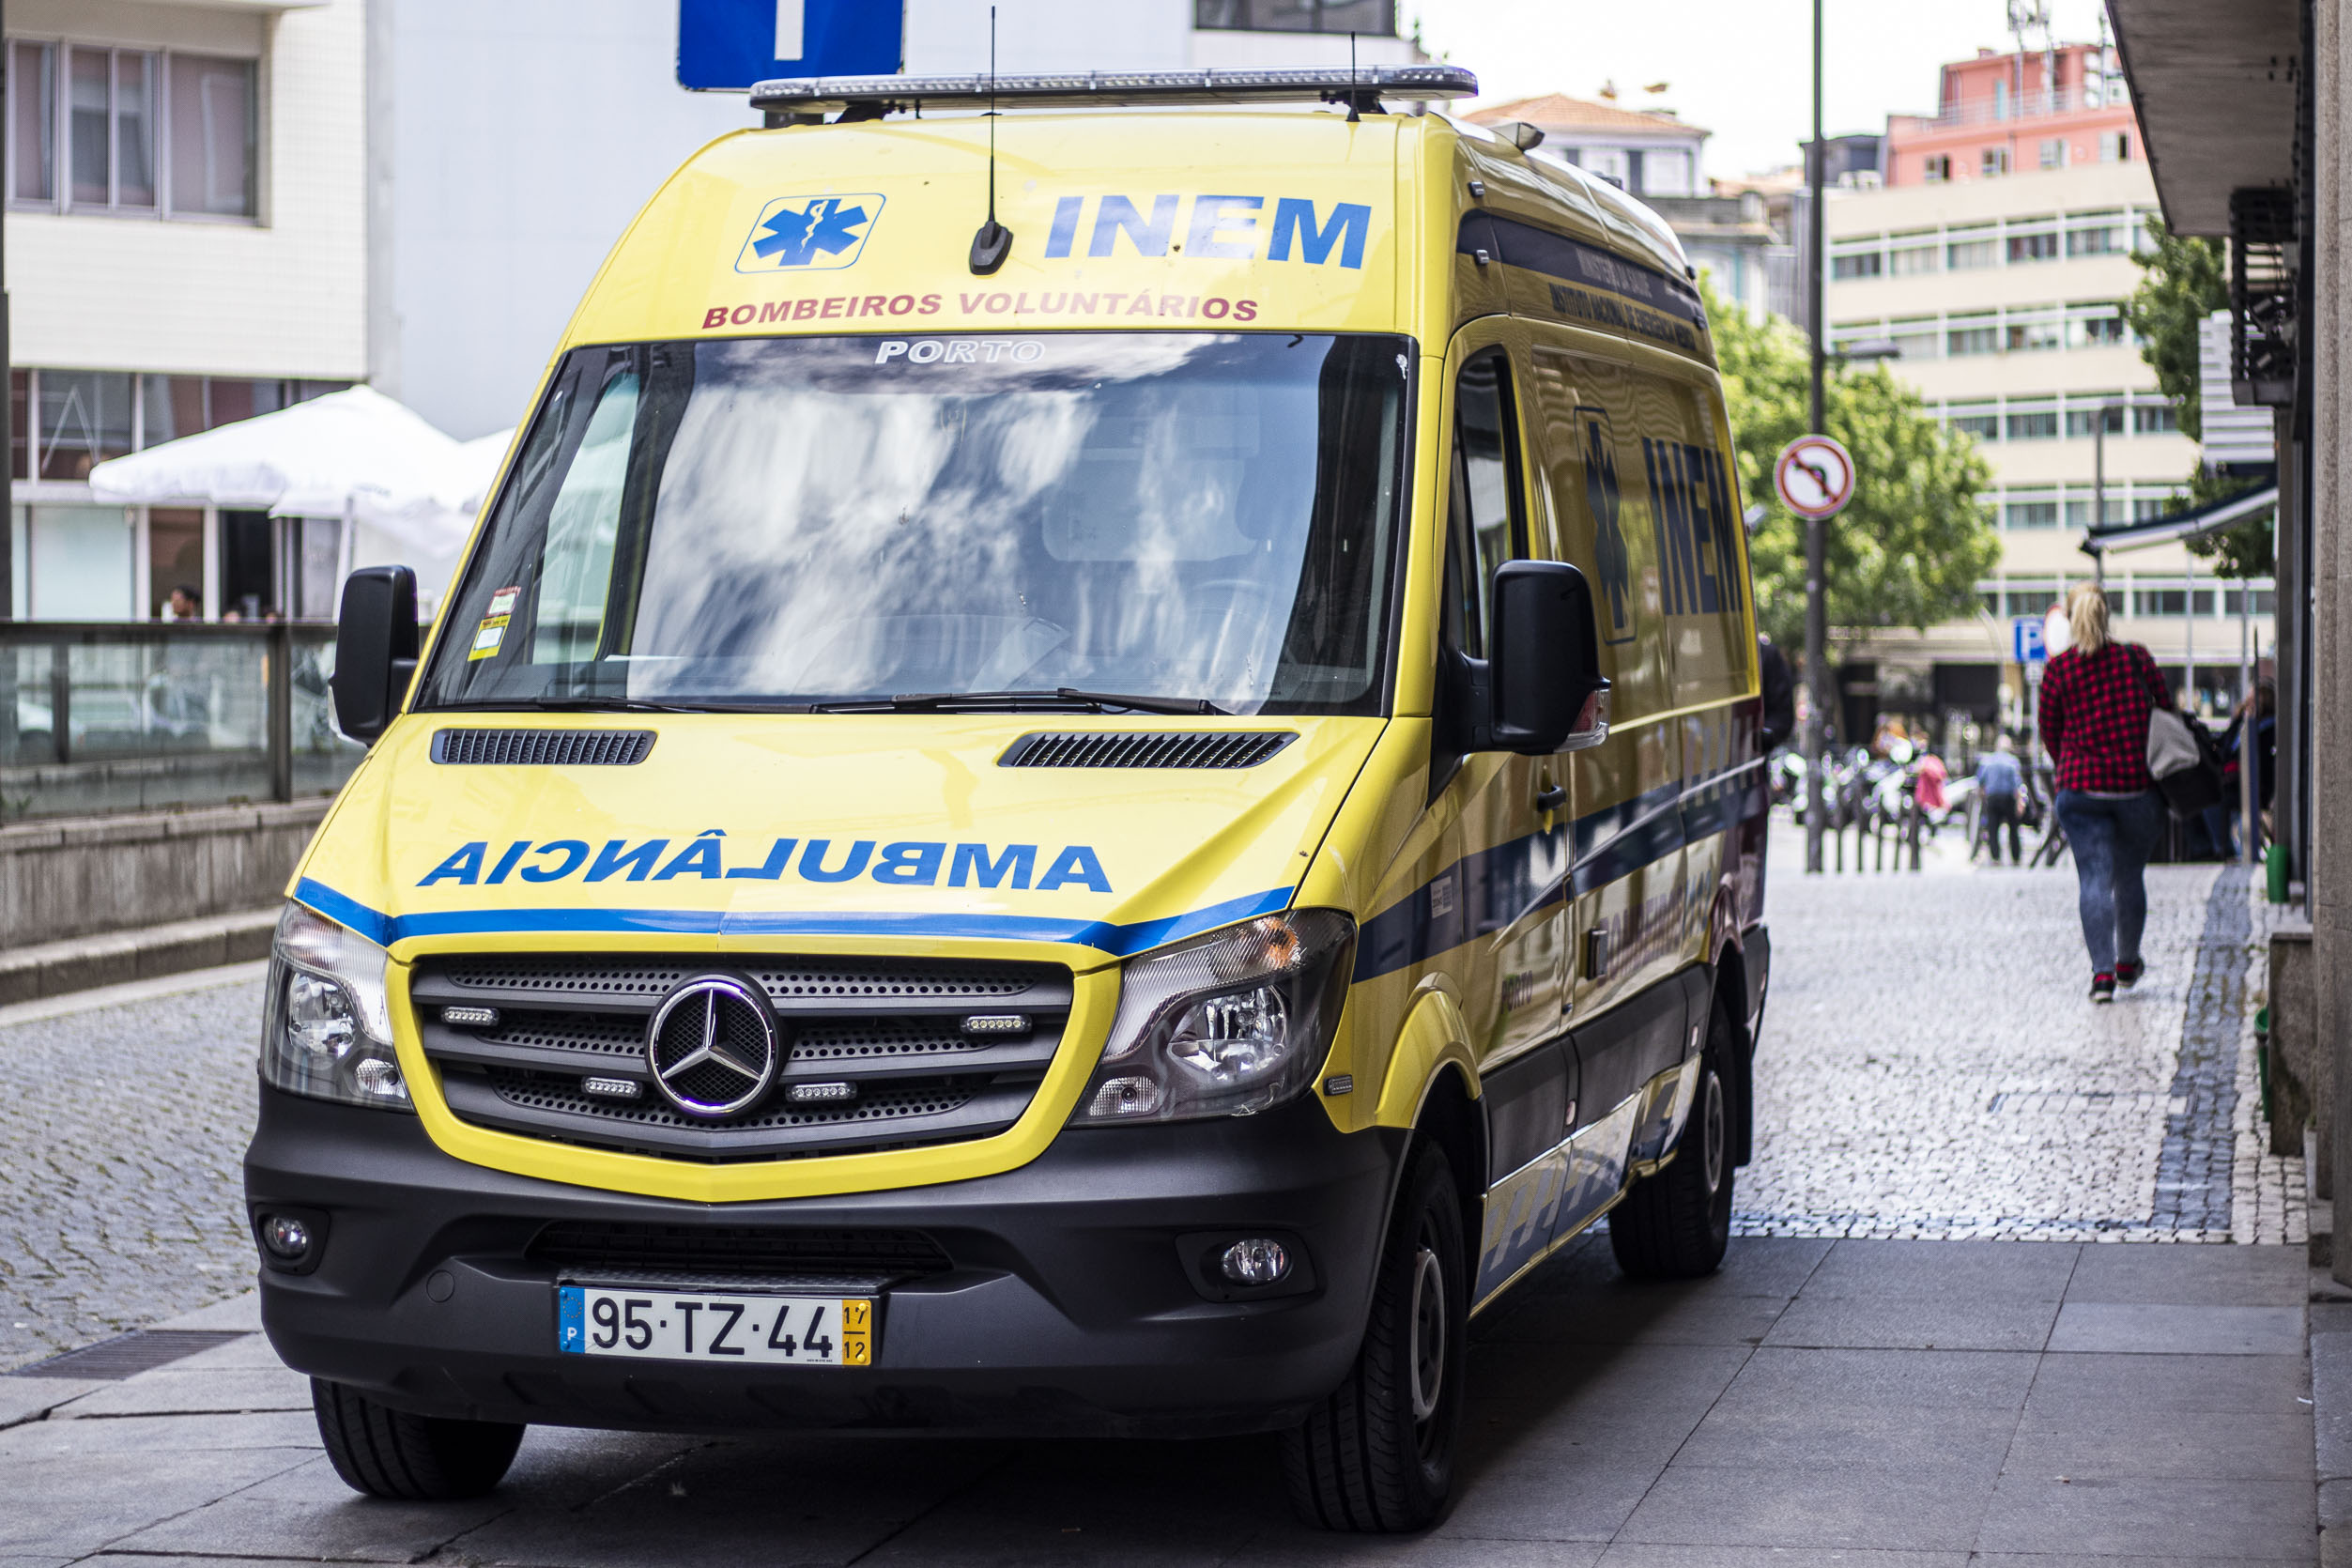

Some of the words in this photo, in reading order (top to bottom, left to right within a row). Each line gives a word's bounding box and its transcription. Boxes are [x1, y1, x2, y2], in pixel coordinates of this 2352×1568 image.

[1044, 193, 1372, 269] INEM
[702, 294, 943, 329] BOMBEIROS
[959, 288, 1258, 321] VOLUNTÁRIOS
[874, 340, 1046, 365] PORTO
[1642, 437, 1745, 616] INEM
[2021, 623, 2044, 659] P
[844, 1306, 865, 1324] 17
[567, 1327, 577, 1341] P
[844, 1342, 865, 1359] 12
